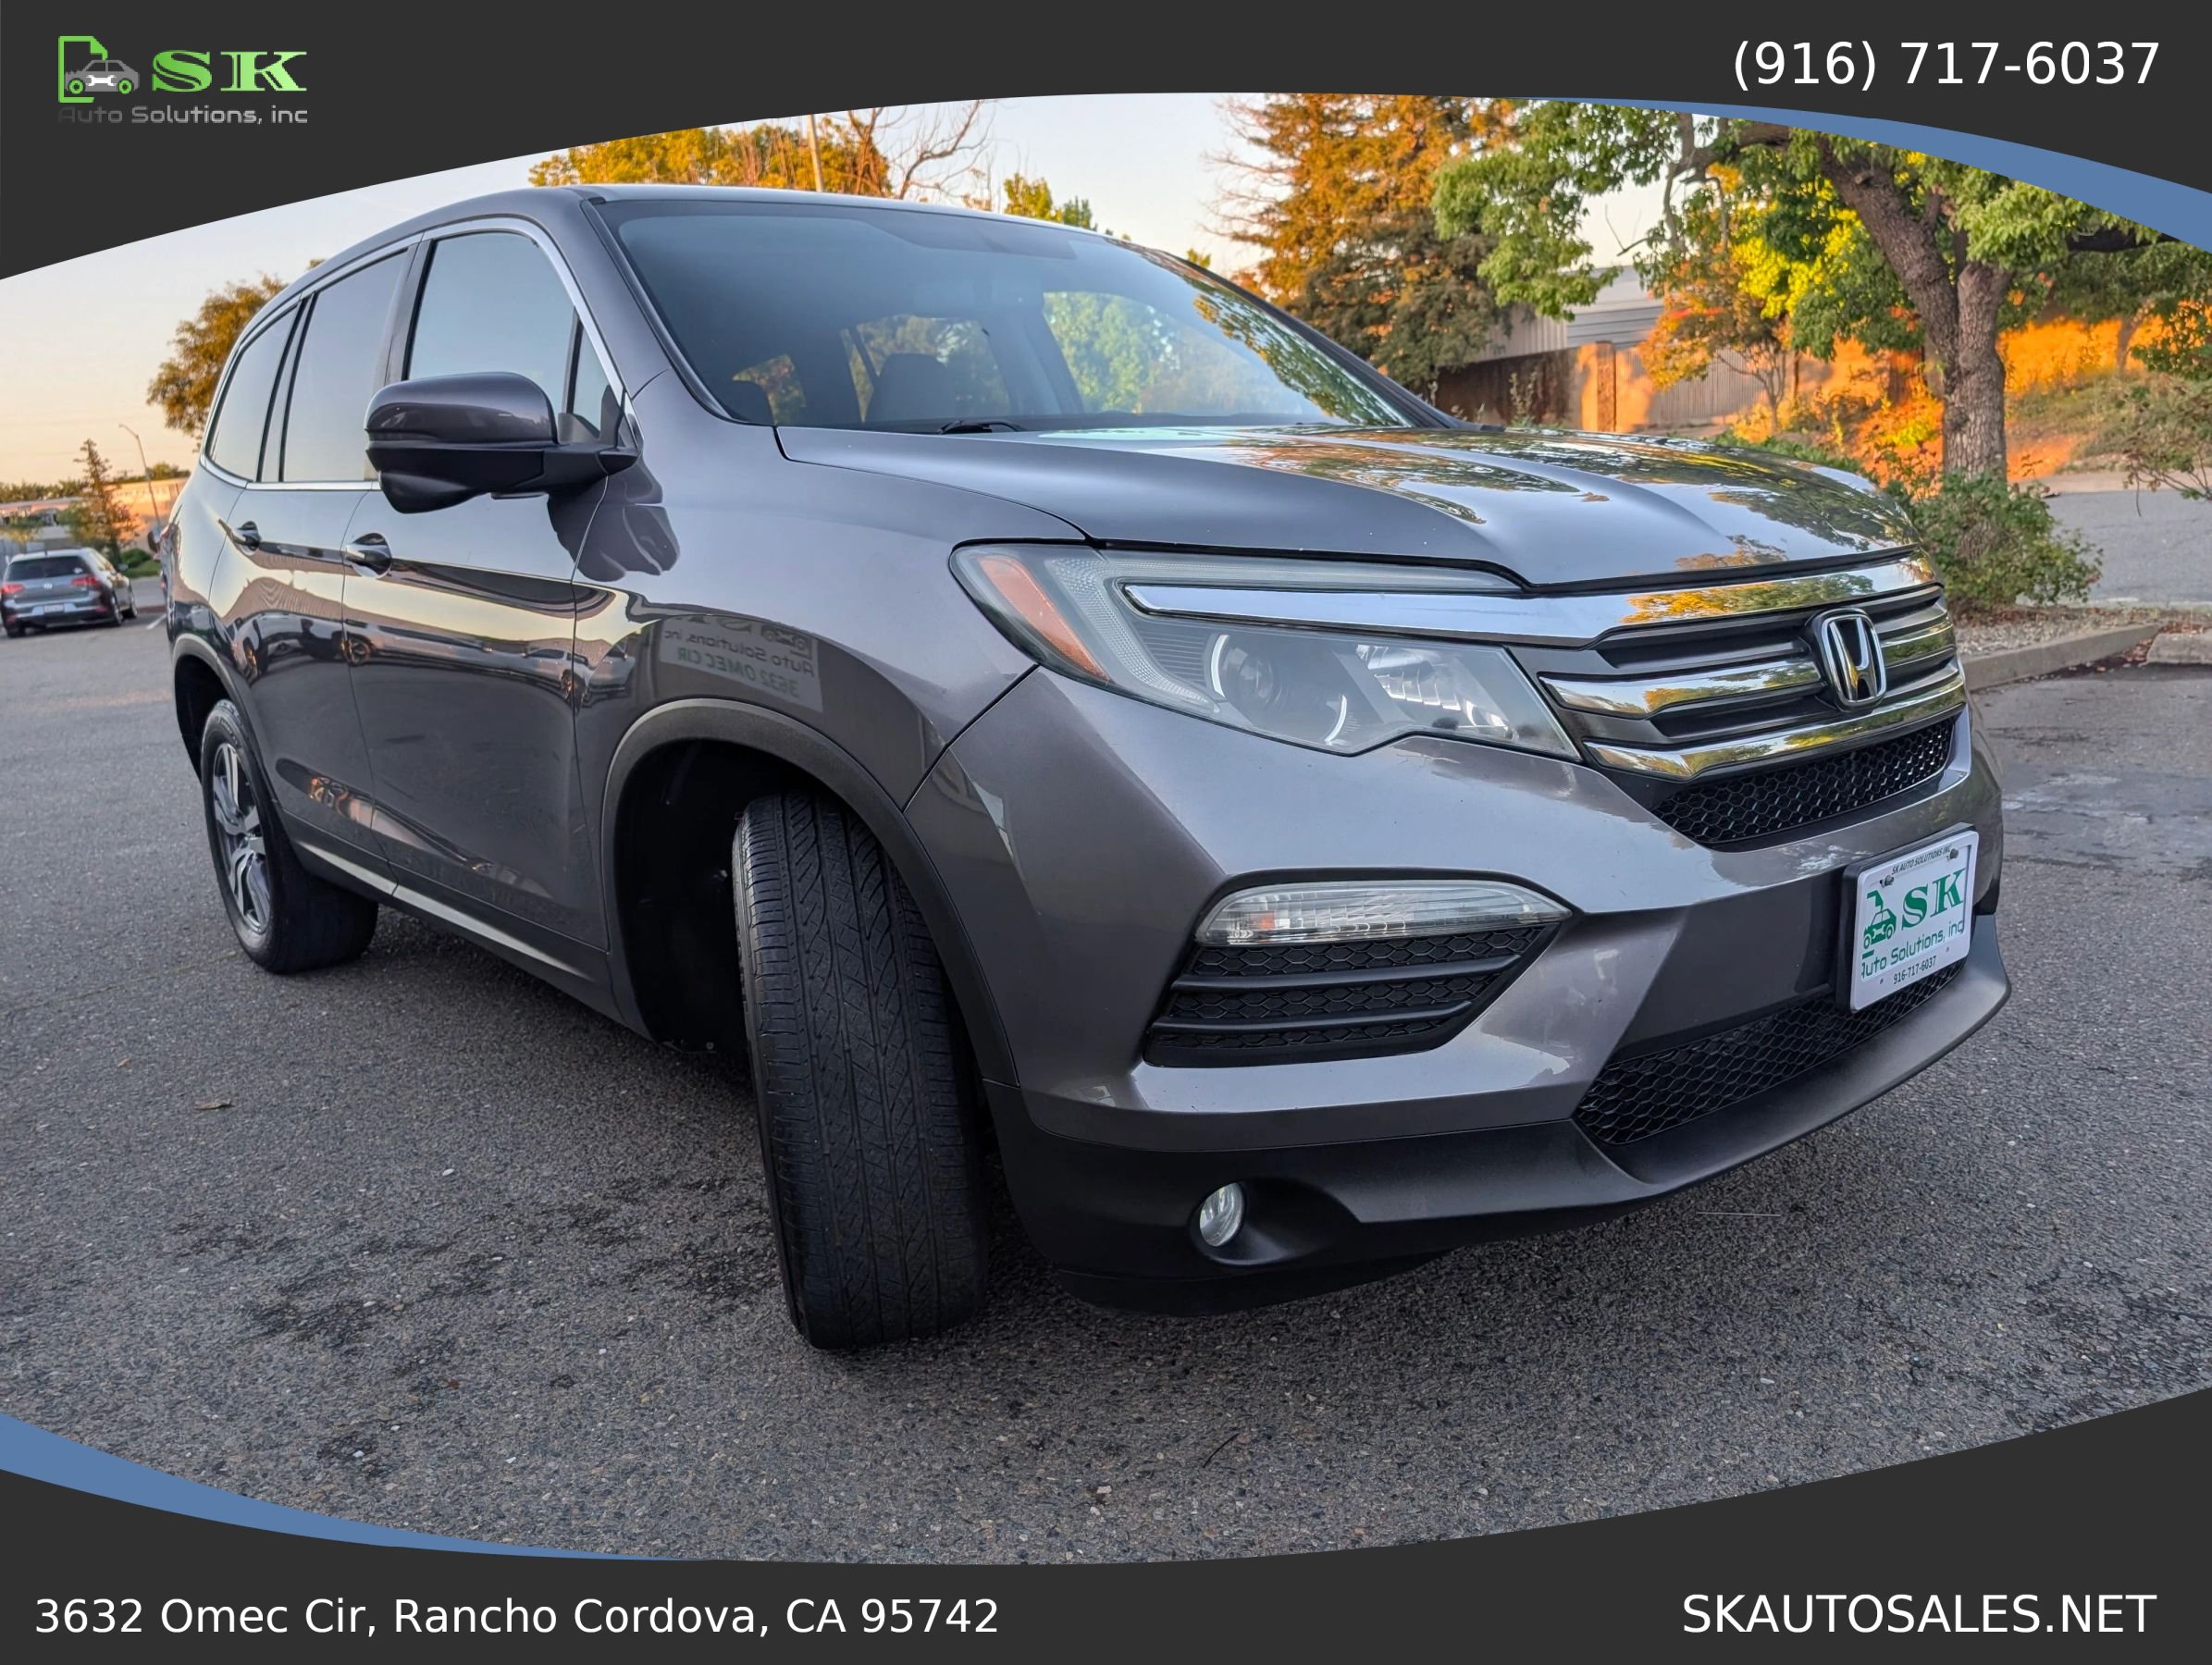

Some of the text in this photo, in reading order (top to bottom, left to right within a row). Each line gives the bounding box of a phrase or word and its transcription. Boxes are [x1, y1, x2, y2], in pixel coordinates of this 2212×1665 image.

[1901, 869, 1966, 931] SK
[1890, 930, 1946, 966] Solutions,
[1893, 956, 1937, 985] 916-717-6037
